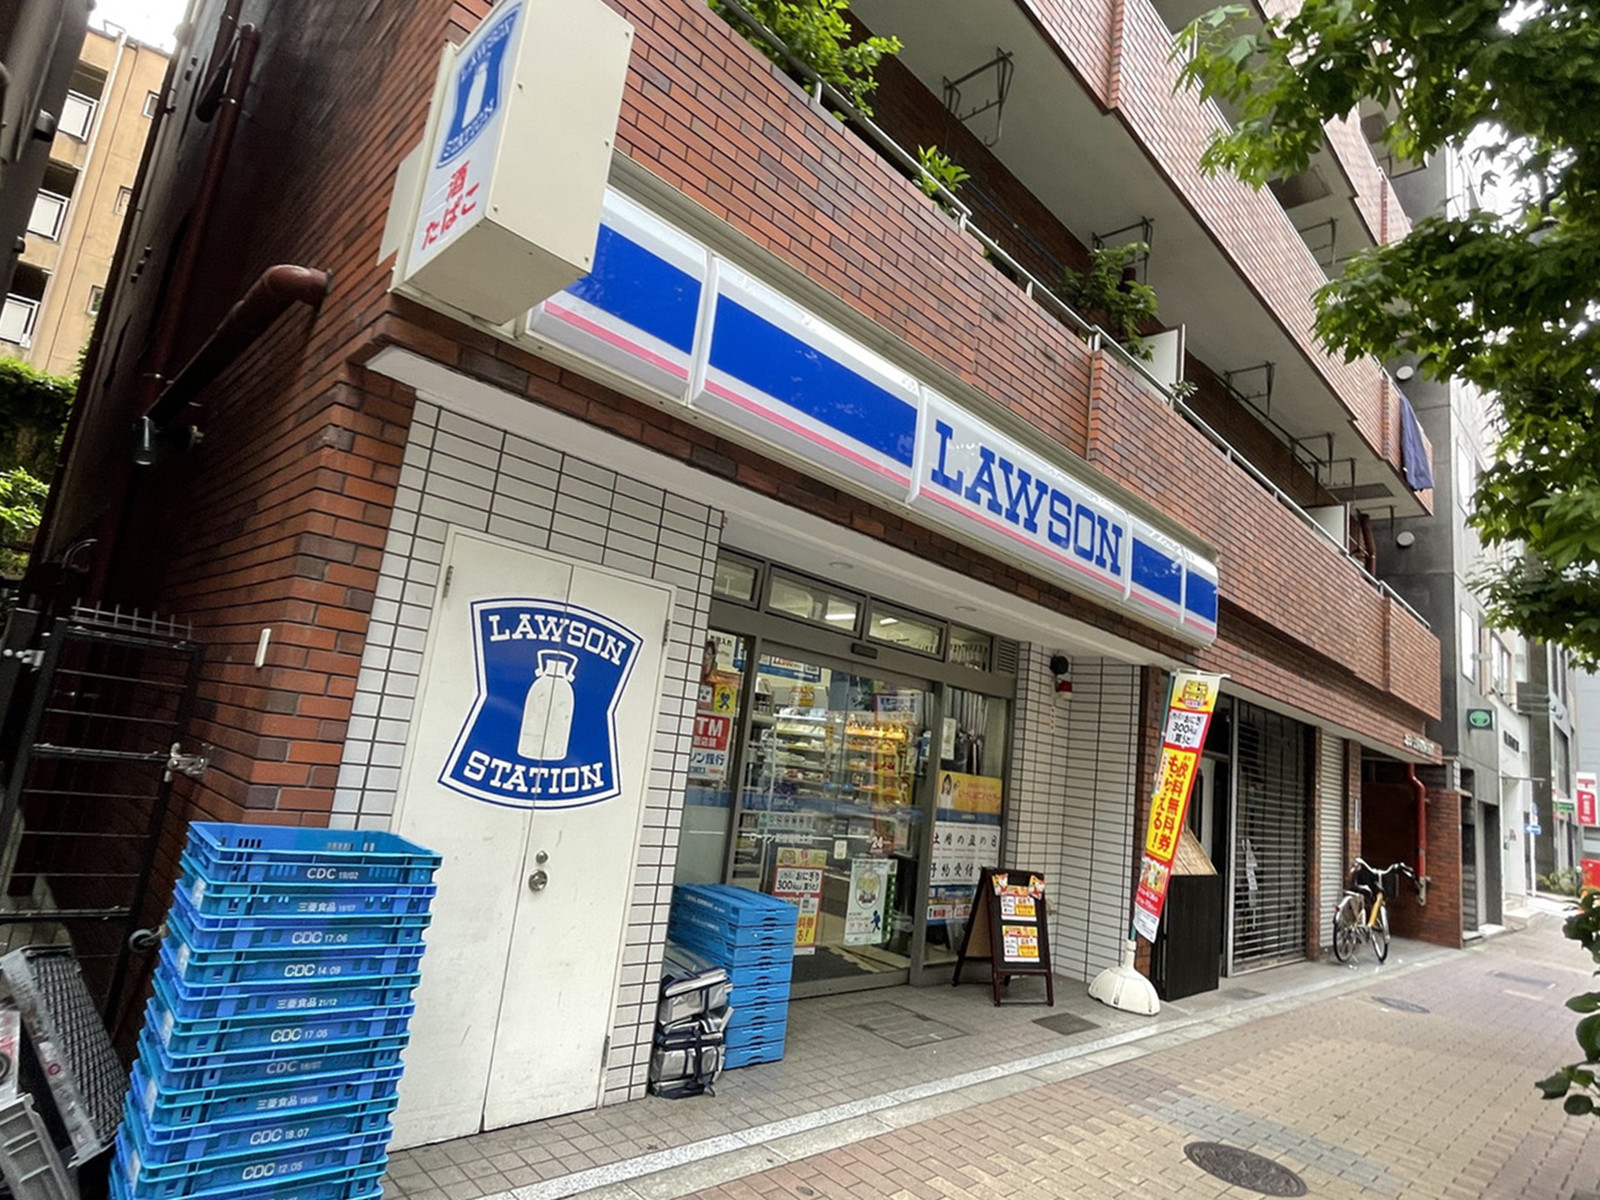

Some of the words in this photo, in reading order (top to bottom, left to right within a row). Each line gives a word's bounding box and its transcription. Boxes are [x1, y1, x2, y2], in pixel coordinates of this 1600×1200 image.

[421, 182, 480, 250] たばこ
[931, 419, 1123, 577] LAWSON
[488, 613, 627, 666] LAWSON
[697, 717, 723, 737] TM
[463, 750, 604, 794] STATION
[306, 867, 337, 879] CDC
[930, 861, 981, 878] 予約受付
[292, 931, 323, 944] CDC
[284, 964, 315, 977] CDC
[271, 1028, 302, 1043] CDC
[266, 1061, 298, 1074] CDC
[250, 1128, 283, 1145] CDC
[242, 1163, 275, 1180] CDC
